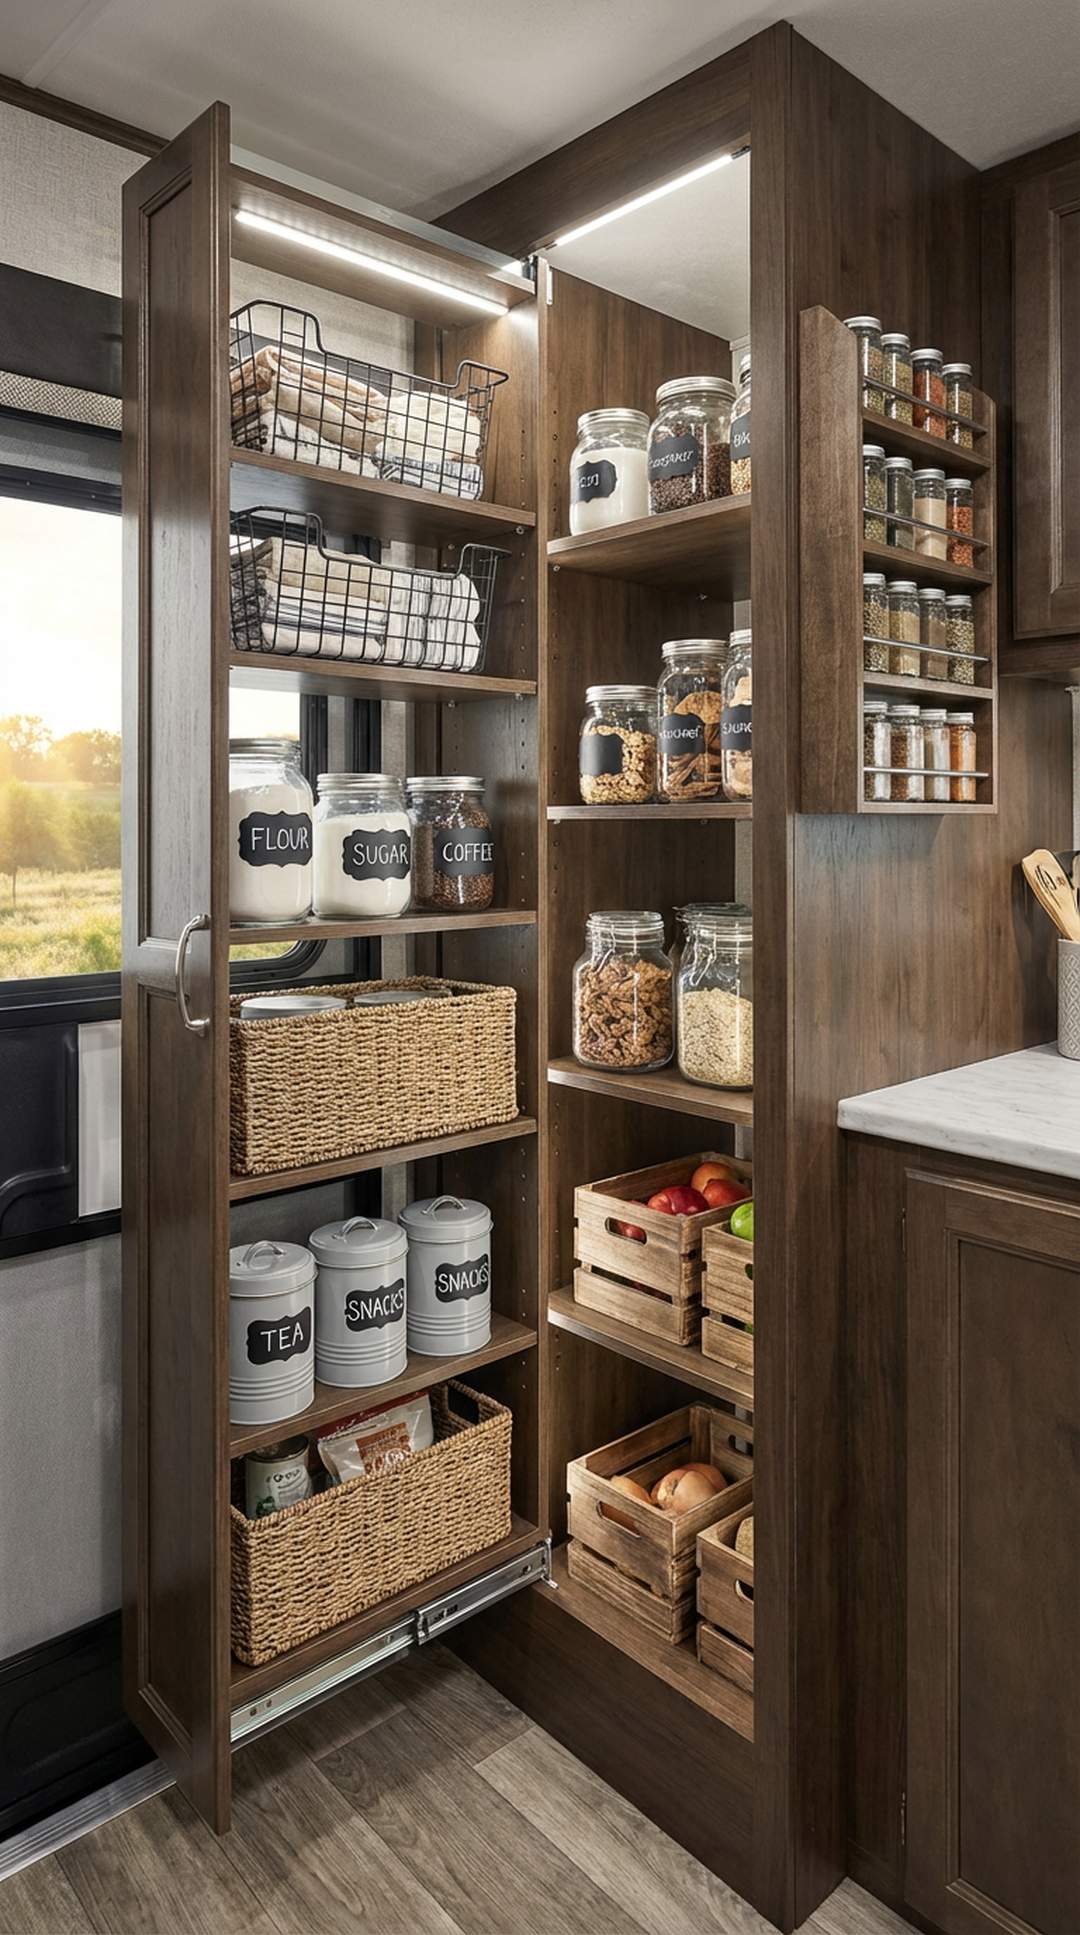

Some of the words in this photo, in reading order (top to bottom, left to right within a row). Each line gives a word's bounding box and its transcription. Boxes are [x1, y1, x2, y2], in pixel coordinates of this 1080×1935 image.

[251, 827, 309, 850] FLOUR
[352, 843, 408, 865] SUGAR
[443, 842, 494, 862] COFFEE
[261, 1322, 304, 1352] TEA
